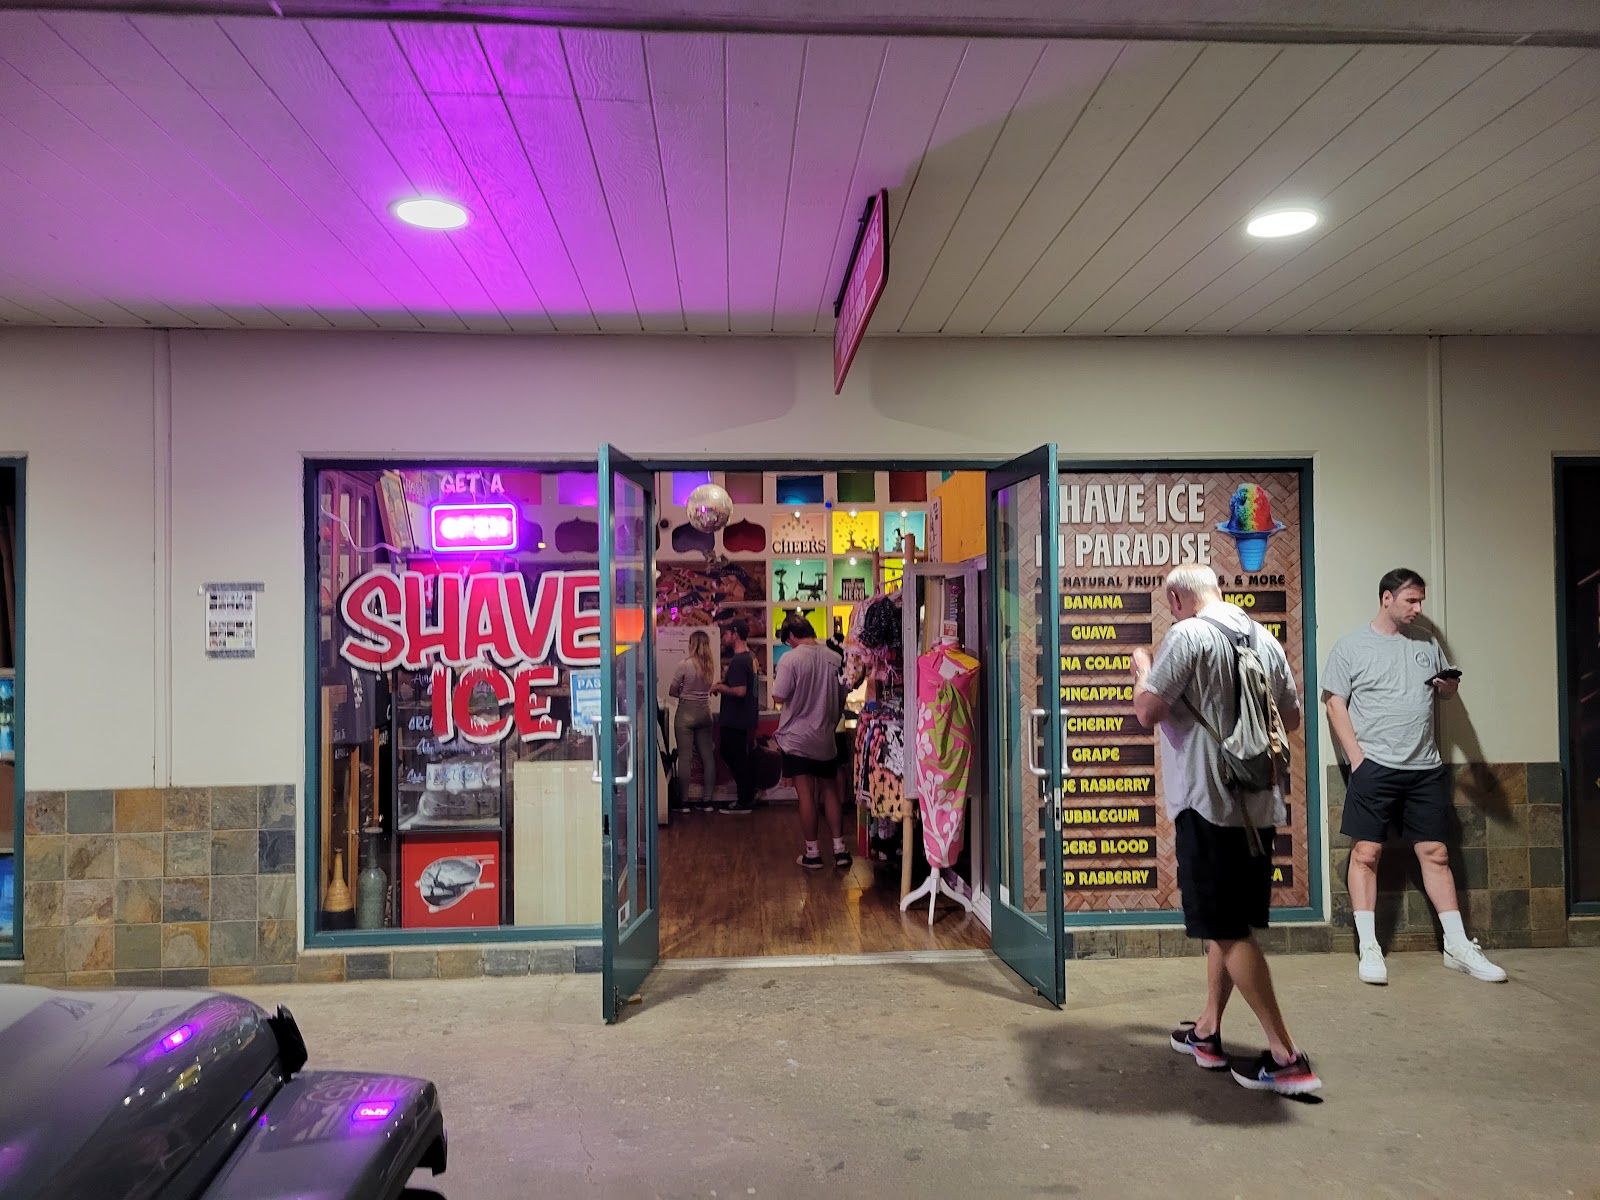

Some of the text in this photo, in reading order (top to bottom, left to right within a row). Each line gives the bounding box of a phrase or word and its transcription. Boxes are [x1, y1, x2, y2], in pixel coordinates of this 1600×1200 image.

[440, 473, 481, 493] GET
[490, 472, 505, 493] A
[1058, 483, 1205, 524] HAVE ICE
[772, 538, 826, 554] CHEERS
[1075, 531, 1212, 567] PARADISE
[1063, 575, 1164, 587] NATURAL FRUIT
[1234, 575, 1245, 585] &
[1248, 574, 1286, 586] MORE
[1063, 595, 1123, 609] BANANA
[1224, 593, 1256, 607] NGO
[340, 569, 600, 672] SHAVE
[1071, 625, 1117, 641] GUAVA
[1060, 656, 1131, 671] NA COLAD
[432, 661, 562, 744] ICE
[1067, 717, 1124, 732] CHERRY
[1072, 748, 1120, 763] GRAPE
[1080, 777, 1150, 793] RASBERRY
[1062, 808, 1140, 824] UBBLEGUM
[1062, 838, 1149, 855] GERS BLOOD
[1079, 869, 1150, 886] RASBERRY
